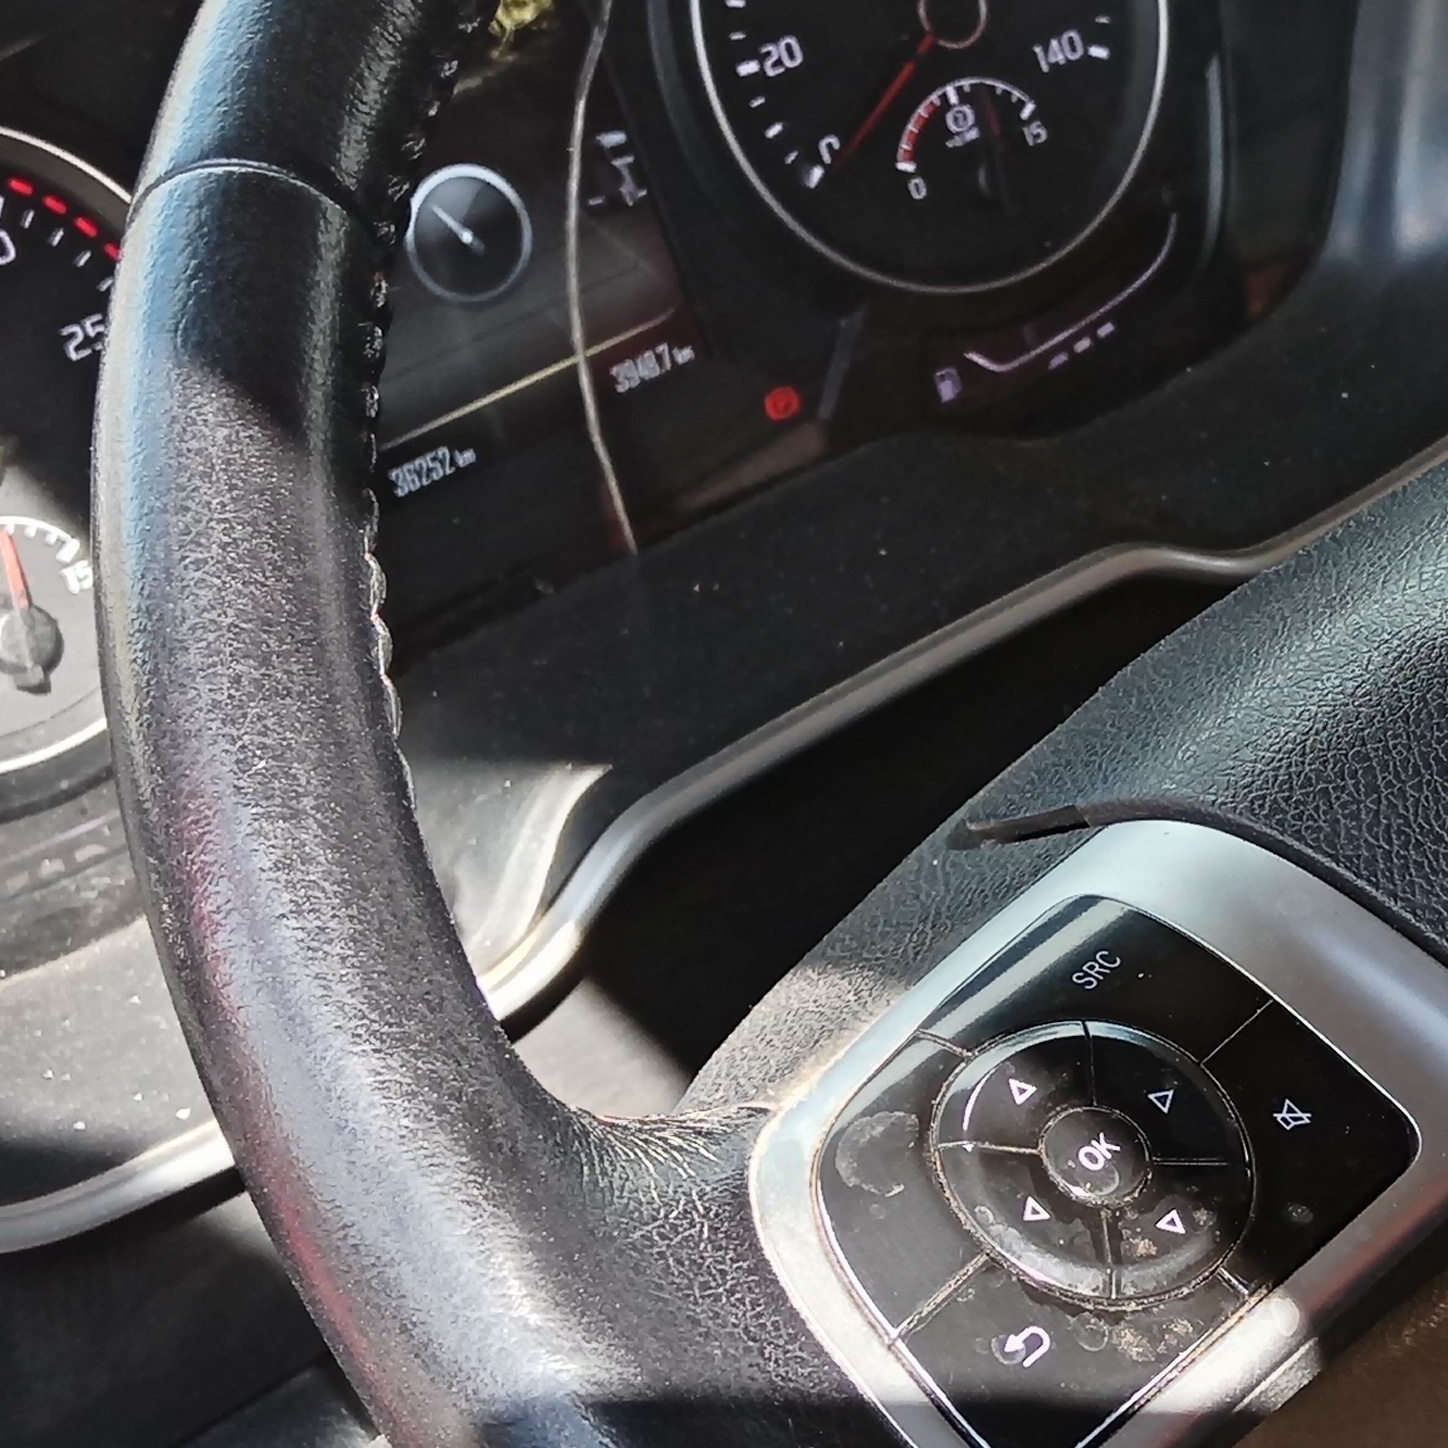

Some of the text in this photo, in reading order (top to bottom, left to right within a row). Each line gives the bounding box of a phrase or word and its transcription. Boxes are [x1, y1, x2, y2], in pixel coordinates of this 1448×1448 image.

[758, 35, 803, 77] 20
[1032, 29, 1084, 73] 140
[1021, 119, 1048, 147] 15
[907, 176, 928, 201] 0
[388, 446, 455, 498] 36252
[1072, 949, 1122, 991] SRC
[1078, 1131, 1121, 1172] OK
